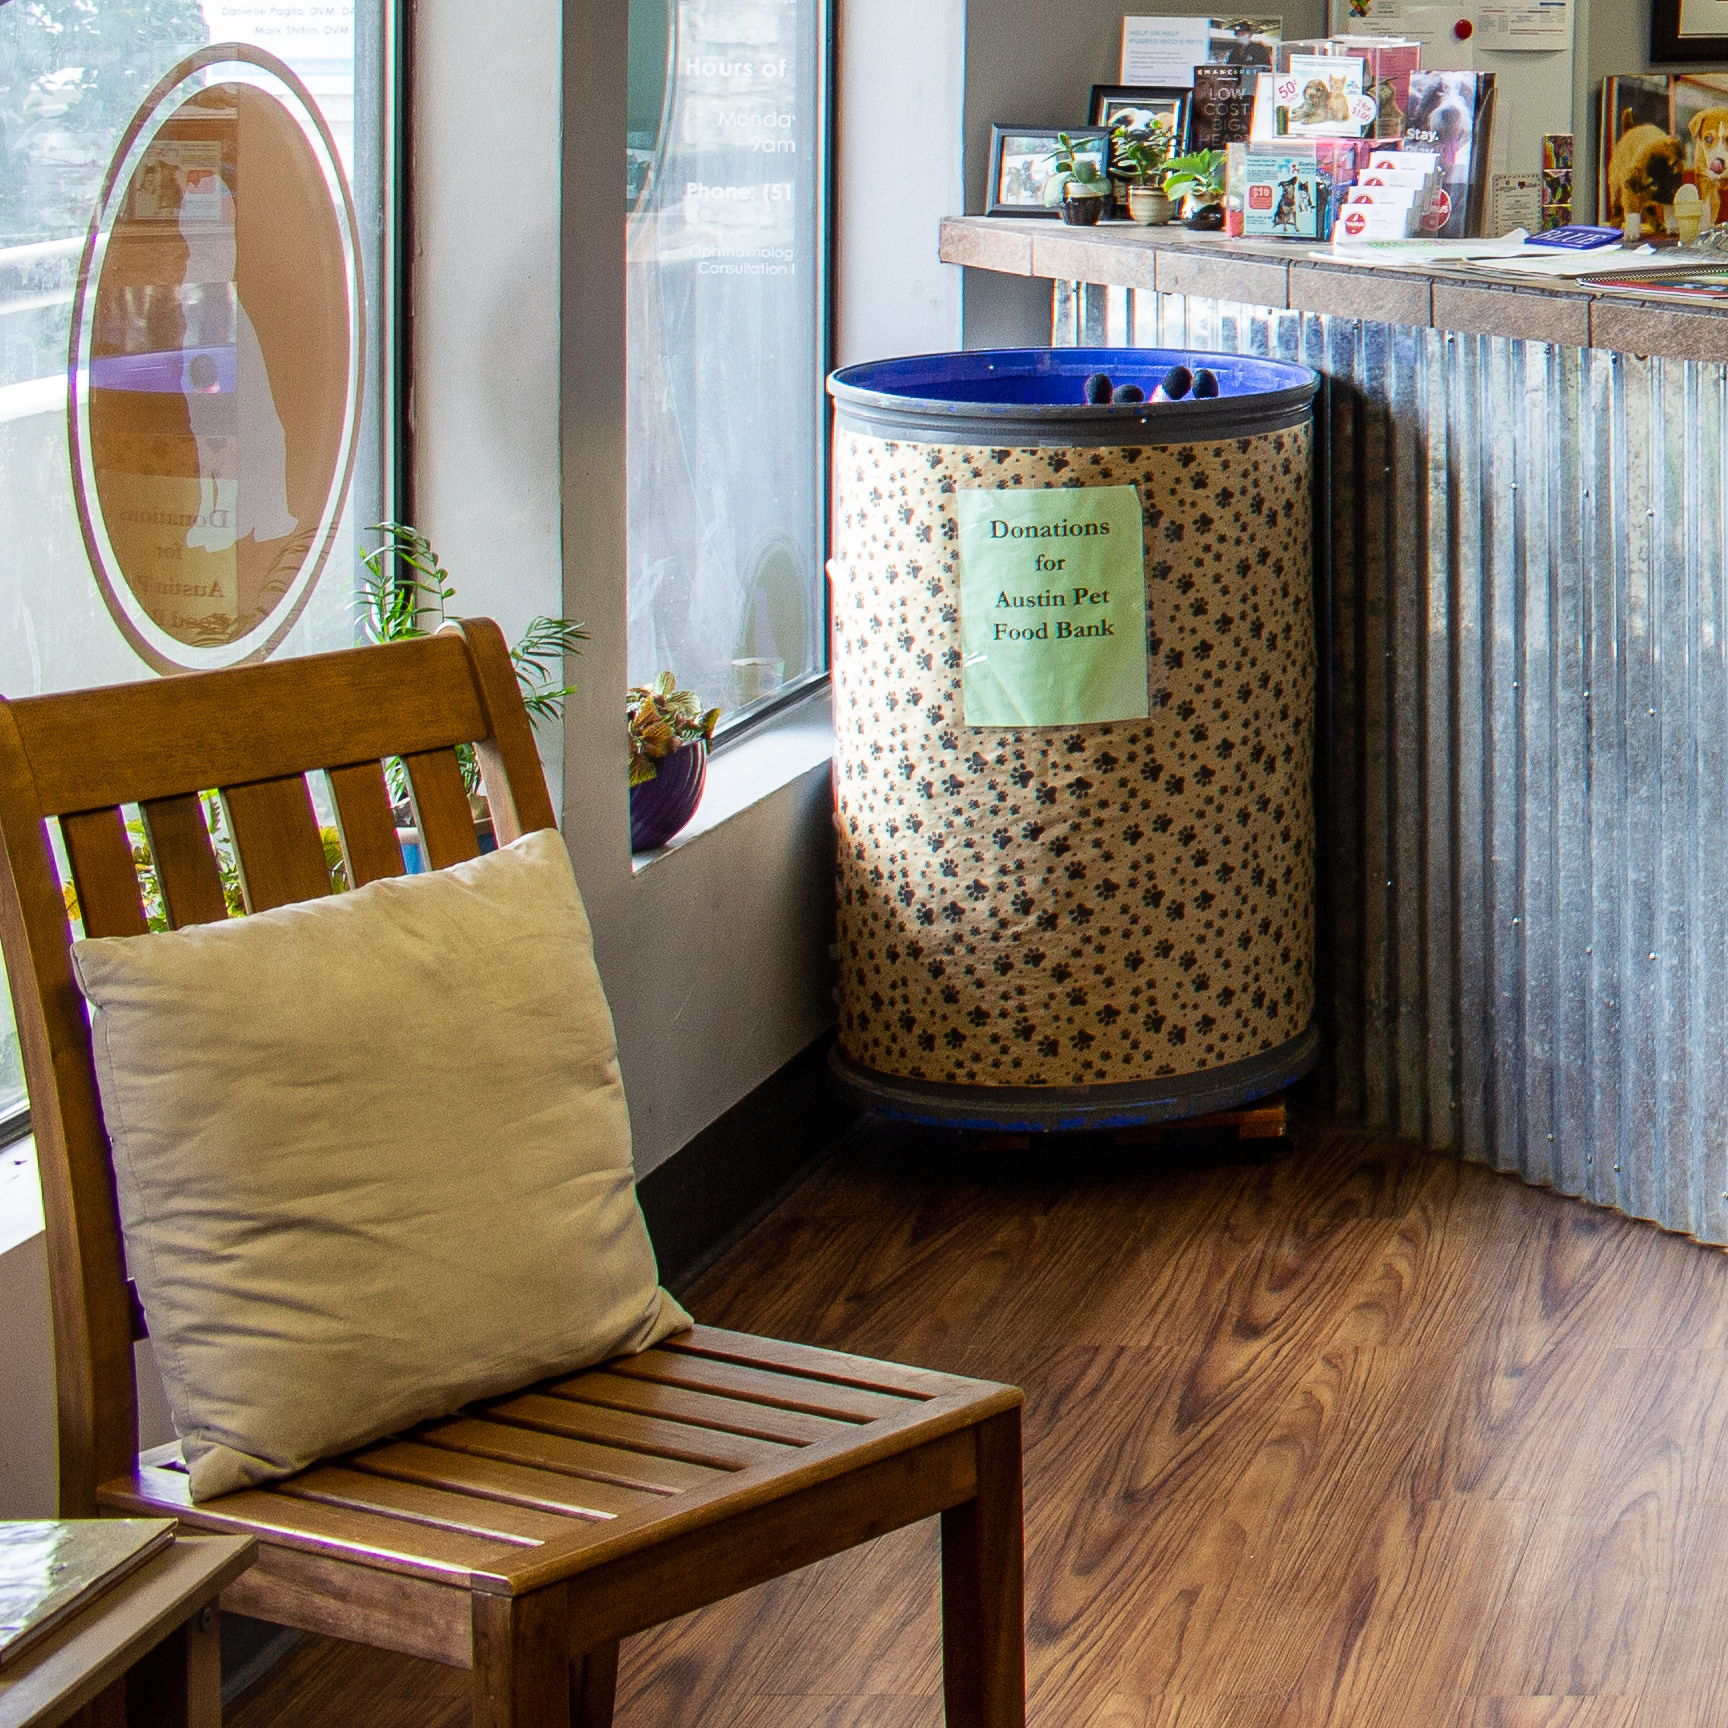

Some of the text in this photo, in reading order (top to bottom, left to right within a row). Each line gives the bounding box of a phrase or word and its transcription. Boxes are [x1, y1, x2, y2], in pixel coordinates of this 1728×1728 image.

[685, 57, 787, 78] Hours of
[1209, 87, 1246, 100] LOW
[1204, 103, 1250, 117] COST
[717, 111, 797, 128] Monda
[752, 135, 796, 153] 9am
[1406, 127, 1439, 144] Stay.
[685, 181, 755, 201] Phone:
[1540, 227, 1607, 246] BLUE
[989, 518, 1111, 539] Donations
[1035, 554, 1066, 572] for
[995, 587, 1110, 608] Austin Pet
[993, 619, 1115, 641] Food Bank
